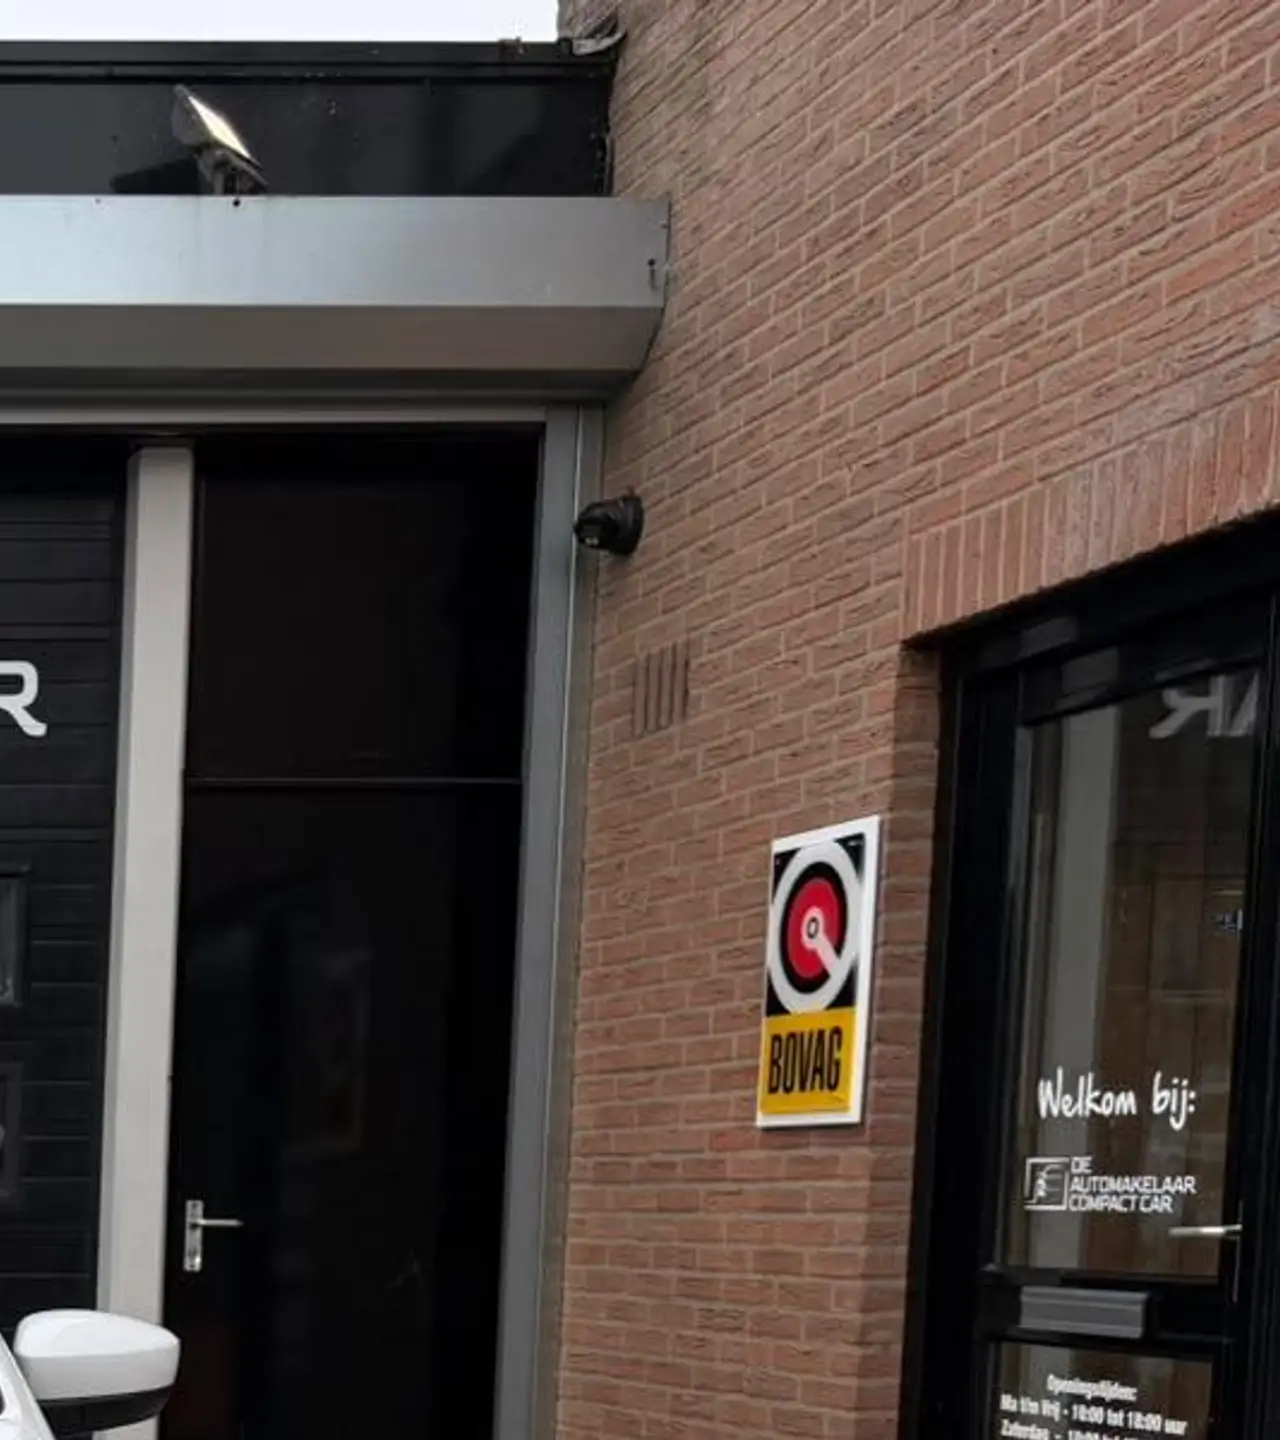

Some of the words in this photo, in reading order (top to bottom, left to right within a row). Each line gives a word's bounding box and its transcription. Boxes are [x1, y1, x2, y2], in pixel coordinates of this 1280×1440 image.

[767, 1025, 843, 1095] BOVAG
[1037, 1066, 1138, 1120] Welkom
[1152, 1070, 1197, 1132] bij:
[1070, 1156, 1092, 1174] DE
[1069, 1175, 1197, 1195] AUTOMAKELAAR
[1068, 1194, 1137, 1213] COMPACT
[1139, 1196, 1174, 1214] CAR
